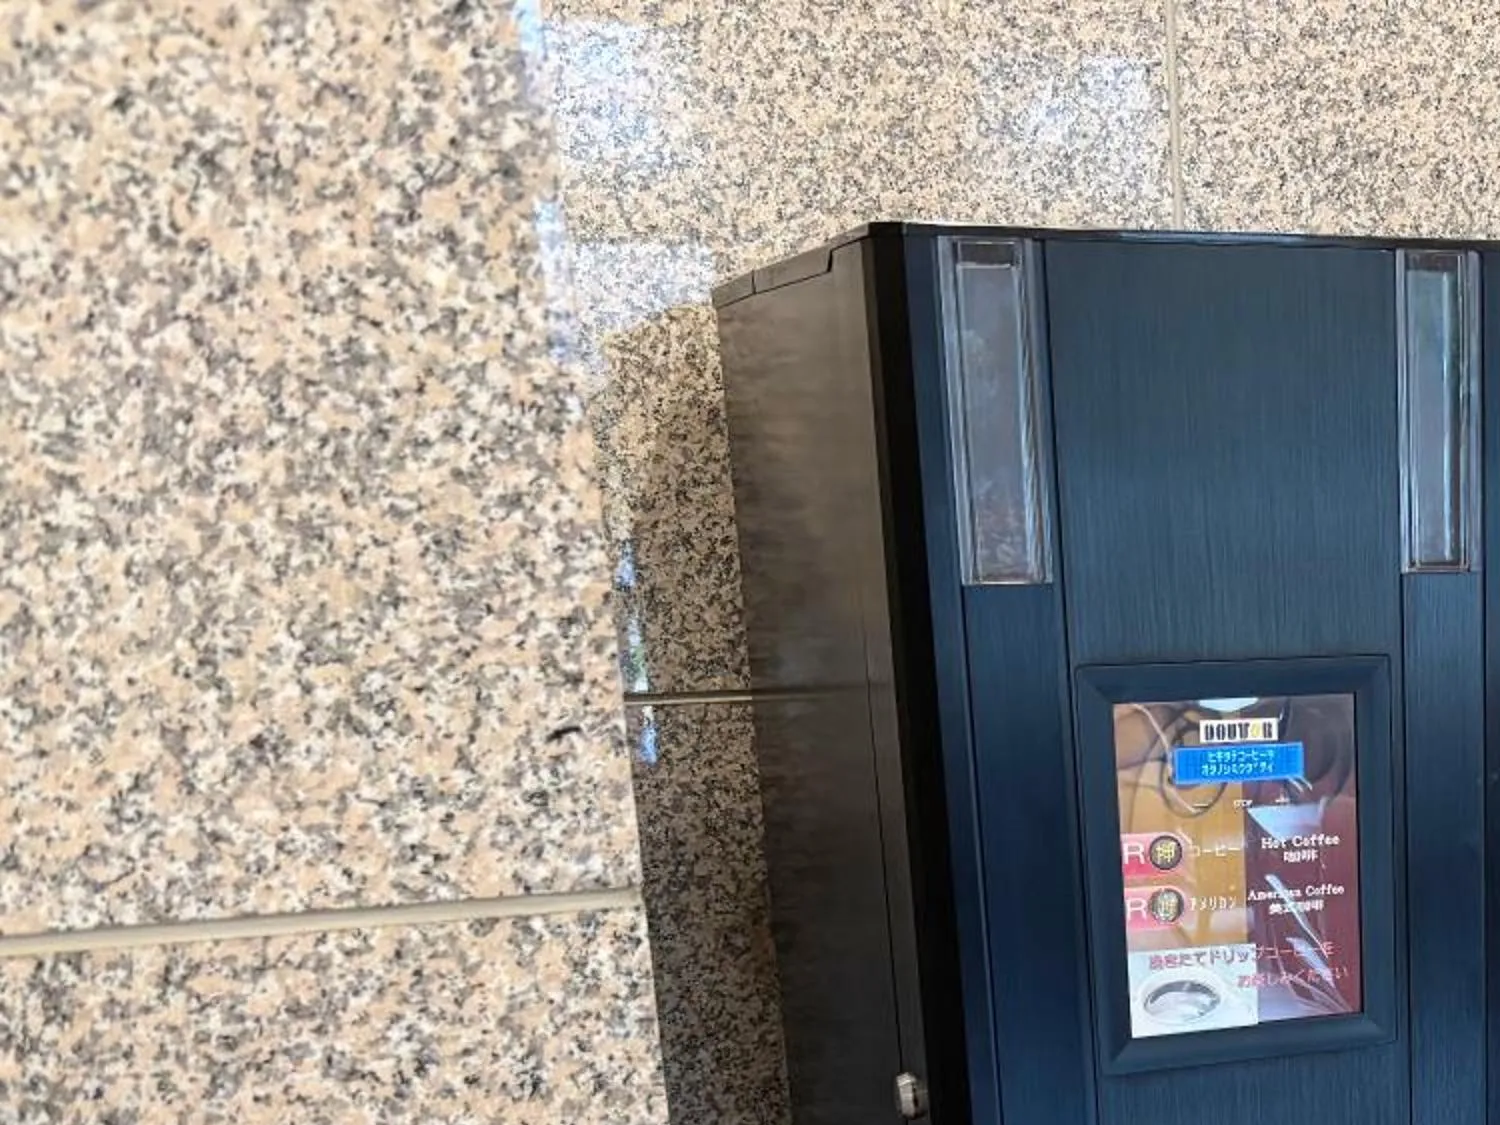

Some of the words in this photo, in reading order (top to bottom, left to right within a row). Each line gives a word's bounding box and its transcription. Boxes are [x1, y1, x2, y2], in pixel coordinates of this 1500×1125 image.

[1204, 721, 1273, 741] DOUTOR
[1261, 837, 1287, 850] Hot
[1292, 833, 1341, 847] Coffee
[1247, 888, 1302, 901] Amercan
[1305, 884, 1345, 897] Coffee
